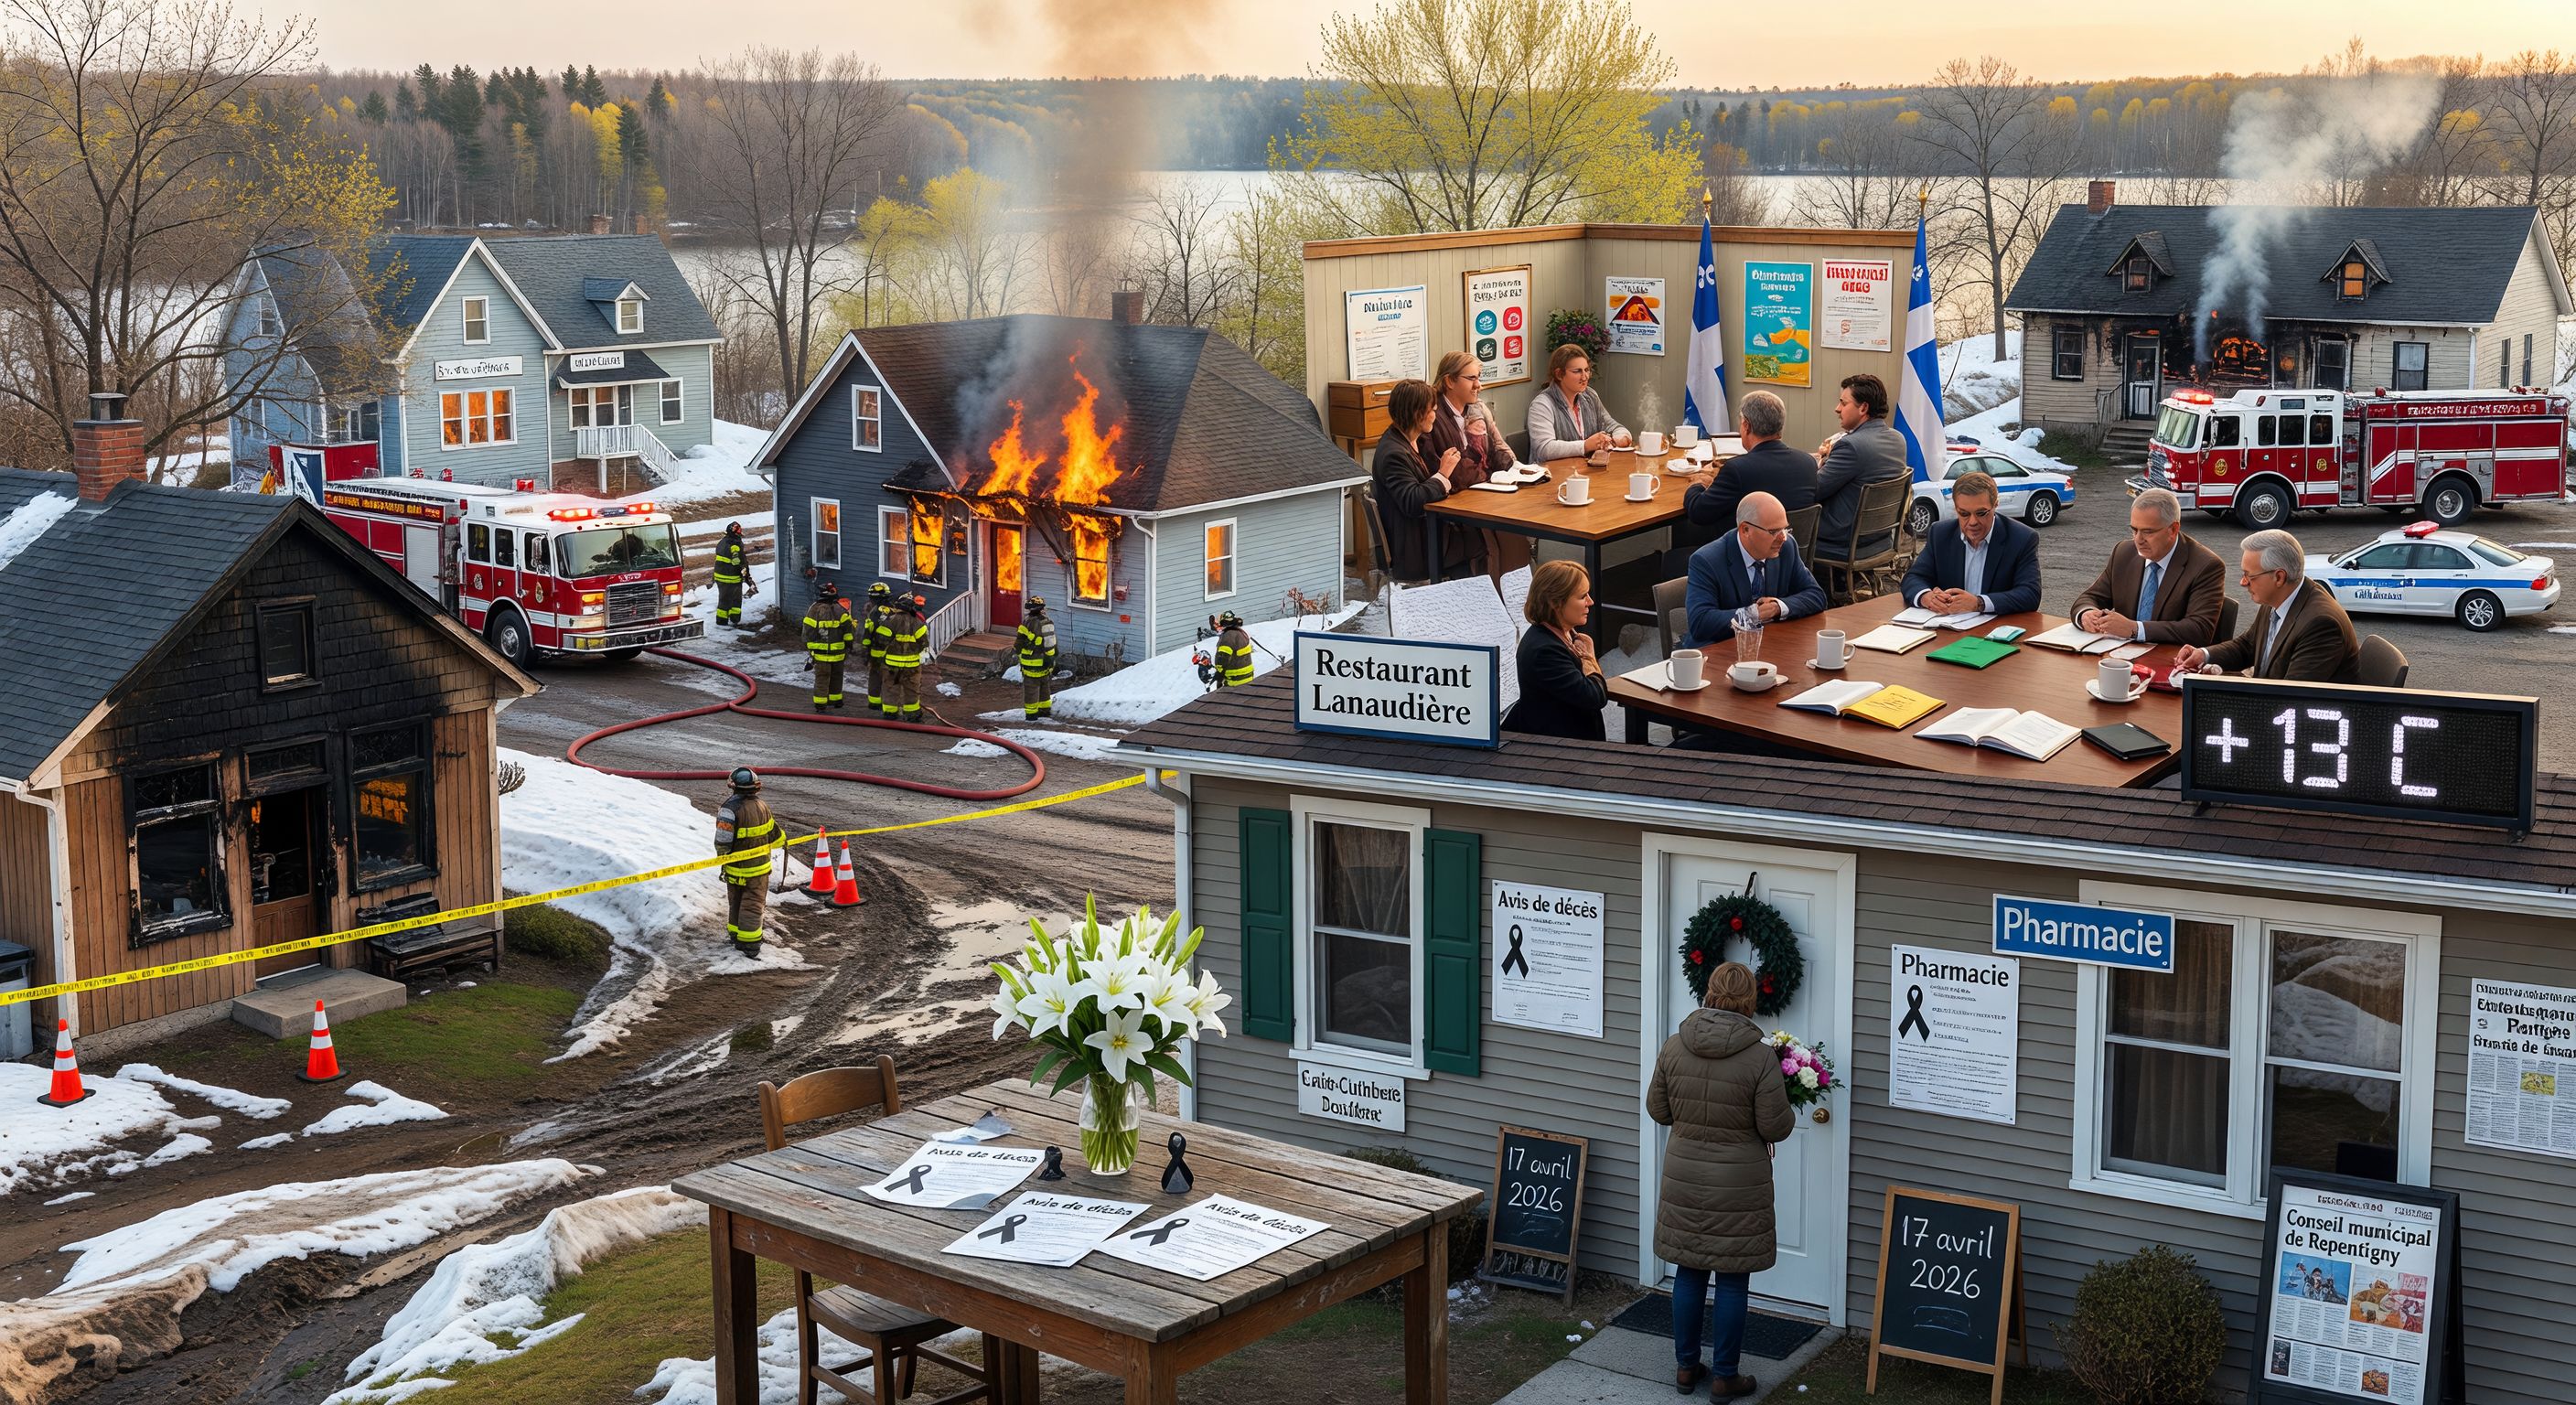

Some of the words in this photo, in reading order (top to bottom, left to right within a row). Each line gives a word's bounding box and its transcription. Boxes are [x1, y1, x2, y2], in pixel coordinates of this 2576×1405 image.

[1315, 648, 1472, 688] Restaurant
[1312, 684, 1471, 725] Lanaudière
[2390, 714, 2440, 799] C
[1497, 890, 1529, 910] Avis
[1532, 895, 1551, 913] de
[1554, 897, 1598, 919] décès
[2003, 906, 2163, 957] Pharmacie
[1901, 953, 2010, 987] Pharmacie
[1508, 1146, 1526, 1171] 17
[1530, 1153, 1572, 1180] avril
[1508, 1182, 1563, 1212] 2026
[1902, 1215, 1929, 1248] 17
[1936, 1225, 1993, 1259] avril
[2286, 1208, 2344, 1234] Conseil
[2348, 1222, 2431, 1248] municipal
[2284, 1229, 2303, 1247] de
[2308, 1232, 2401, 1268] Repentigny
[1909, 1259, 1980, 1299] 2026
